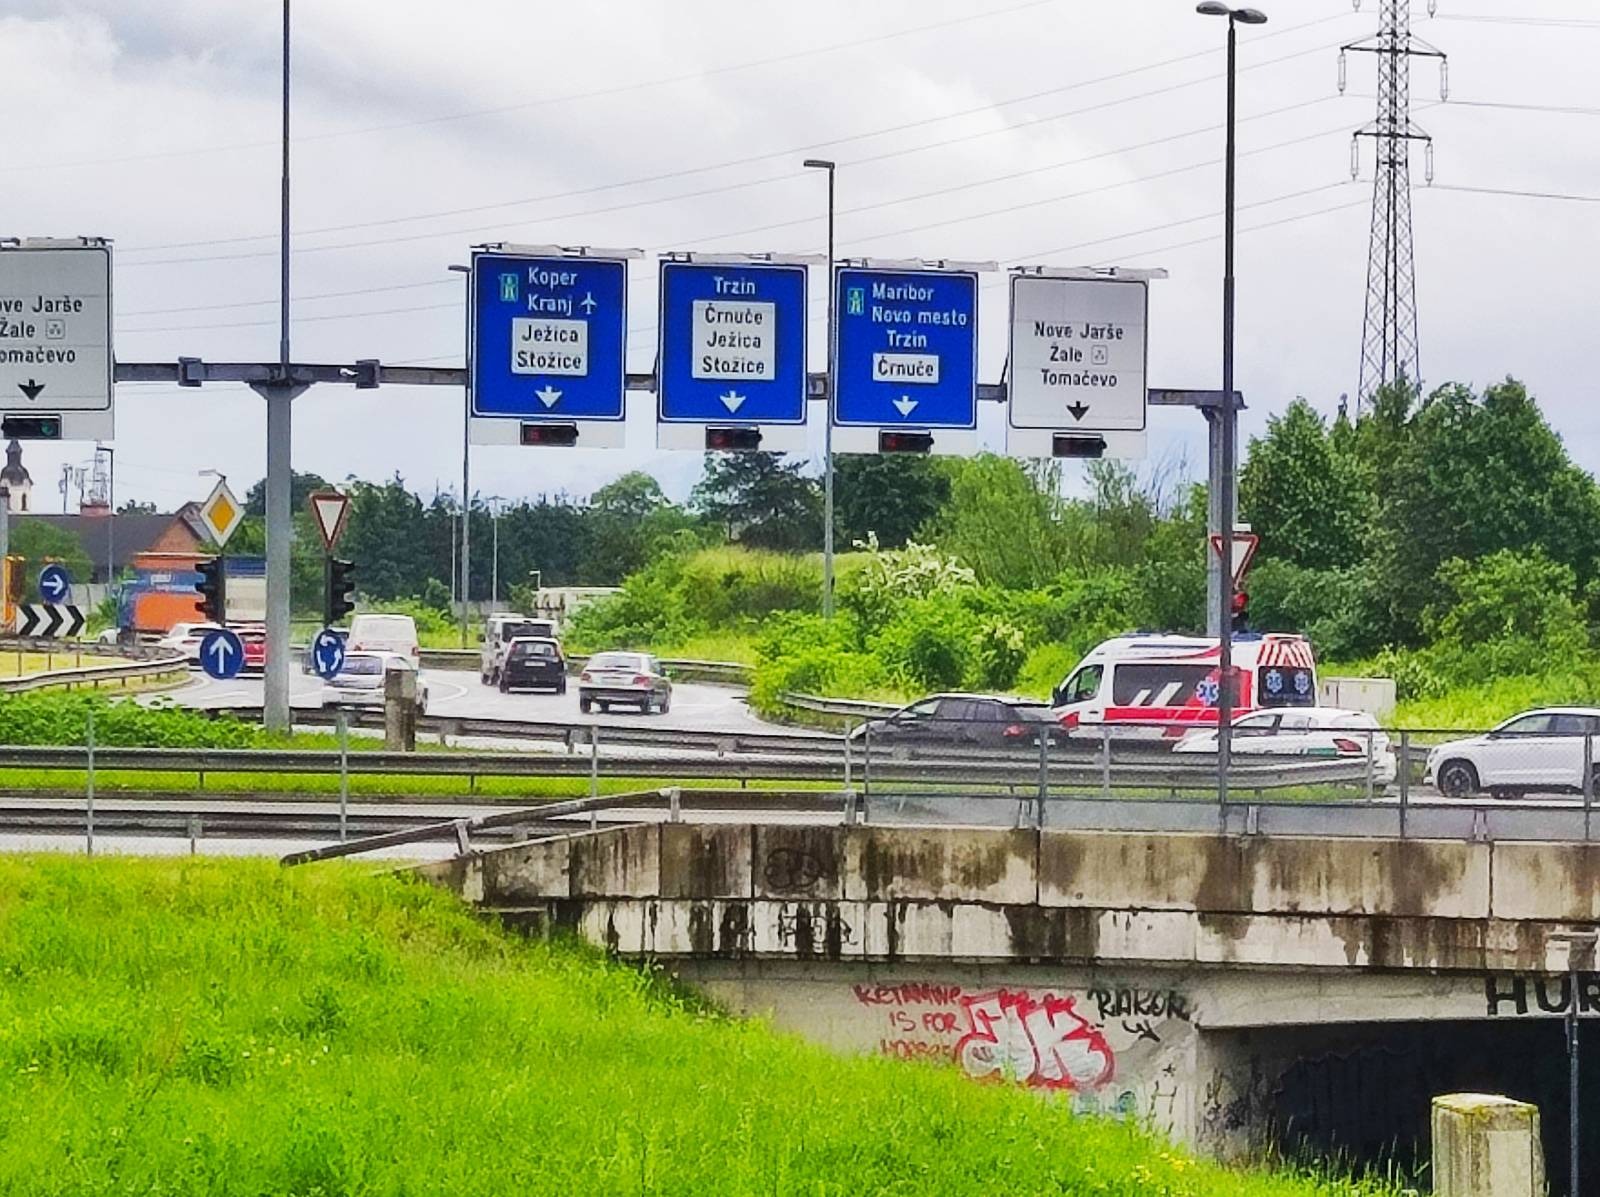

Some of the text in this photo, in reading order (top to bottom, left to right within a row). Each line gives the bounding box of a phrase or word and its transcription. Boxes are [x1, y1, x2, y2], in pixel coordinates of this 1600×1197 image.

[528, 267, 578, 290] Koper
[714, 276, 756, 295] Trzin
[872, 282, 935, 302] Maribor
[32, 295, 83, 313] Jarše
[527, 294, 573, 317] Kranj
[705, 303, 763, 325] Črnuče
[872, 306, 967, 326] Novo mesto
[0, 317, 36, 338] Žale
[521, 325, 579, 343] Ježica
[1034, 321, 1124, 341] Nove Jarše
[706, 331, 761, 349] Ježica
[886, 329, 928, 348] Trzin
[517, 350, 582, 370] Stožice
[1049, 342, 1083, 362] Žale
[702, 355, 765, 375] Stožice
[877, 356, 934, 377] Črnuče
[1041, 368, 1118, 388] Tomačevo
[889, 1010, 962, 1035] IS FOR
